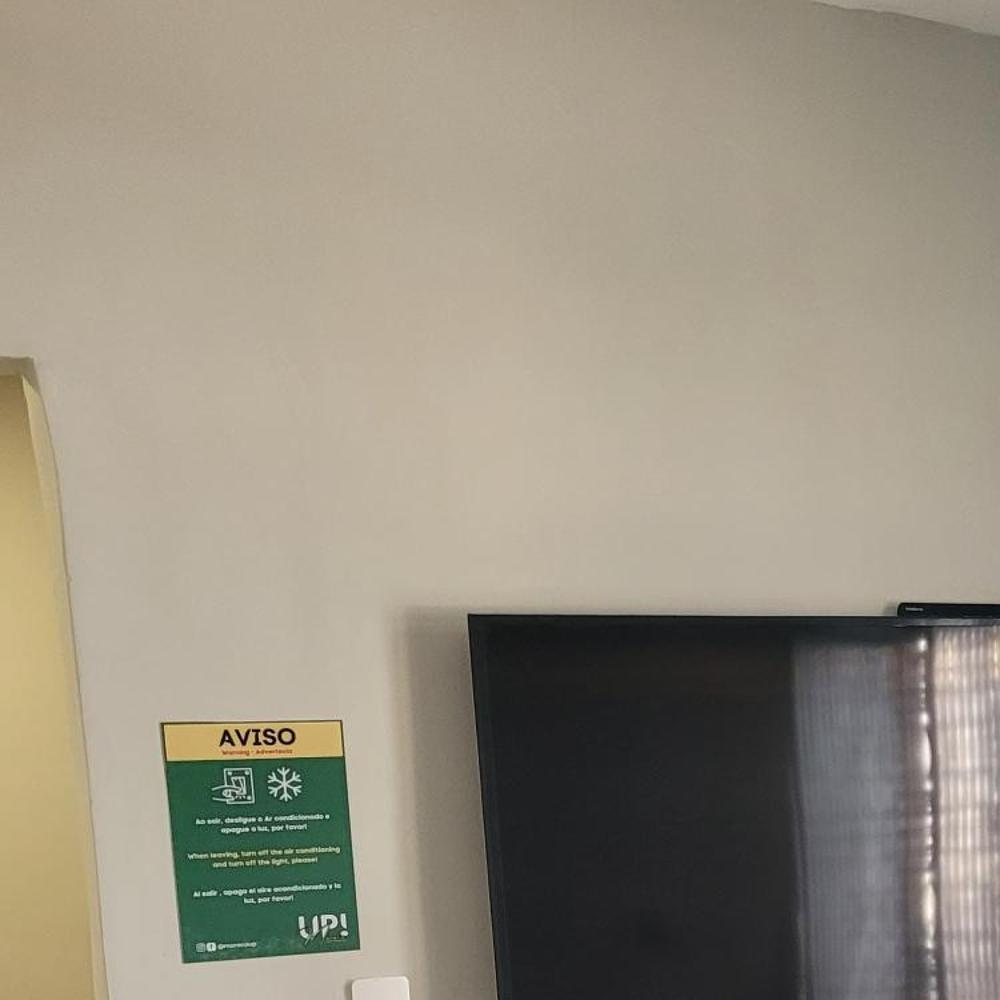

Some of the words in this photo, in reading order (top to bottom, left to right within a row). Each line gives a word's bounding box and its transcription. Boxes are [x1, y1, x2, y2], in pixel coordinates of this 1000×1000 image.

[219, 727, 296, 747] AVISO
[273, 884, 328, 892] acondicionado
[298, 913, 349, 944] UP!
